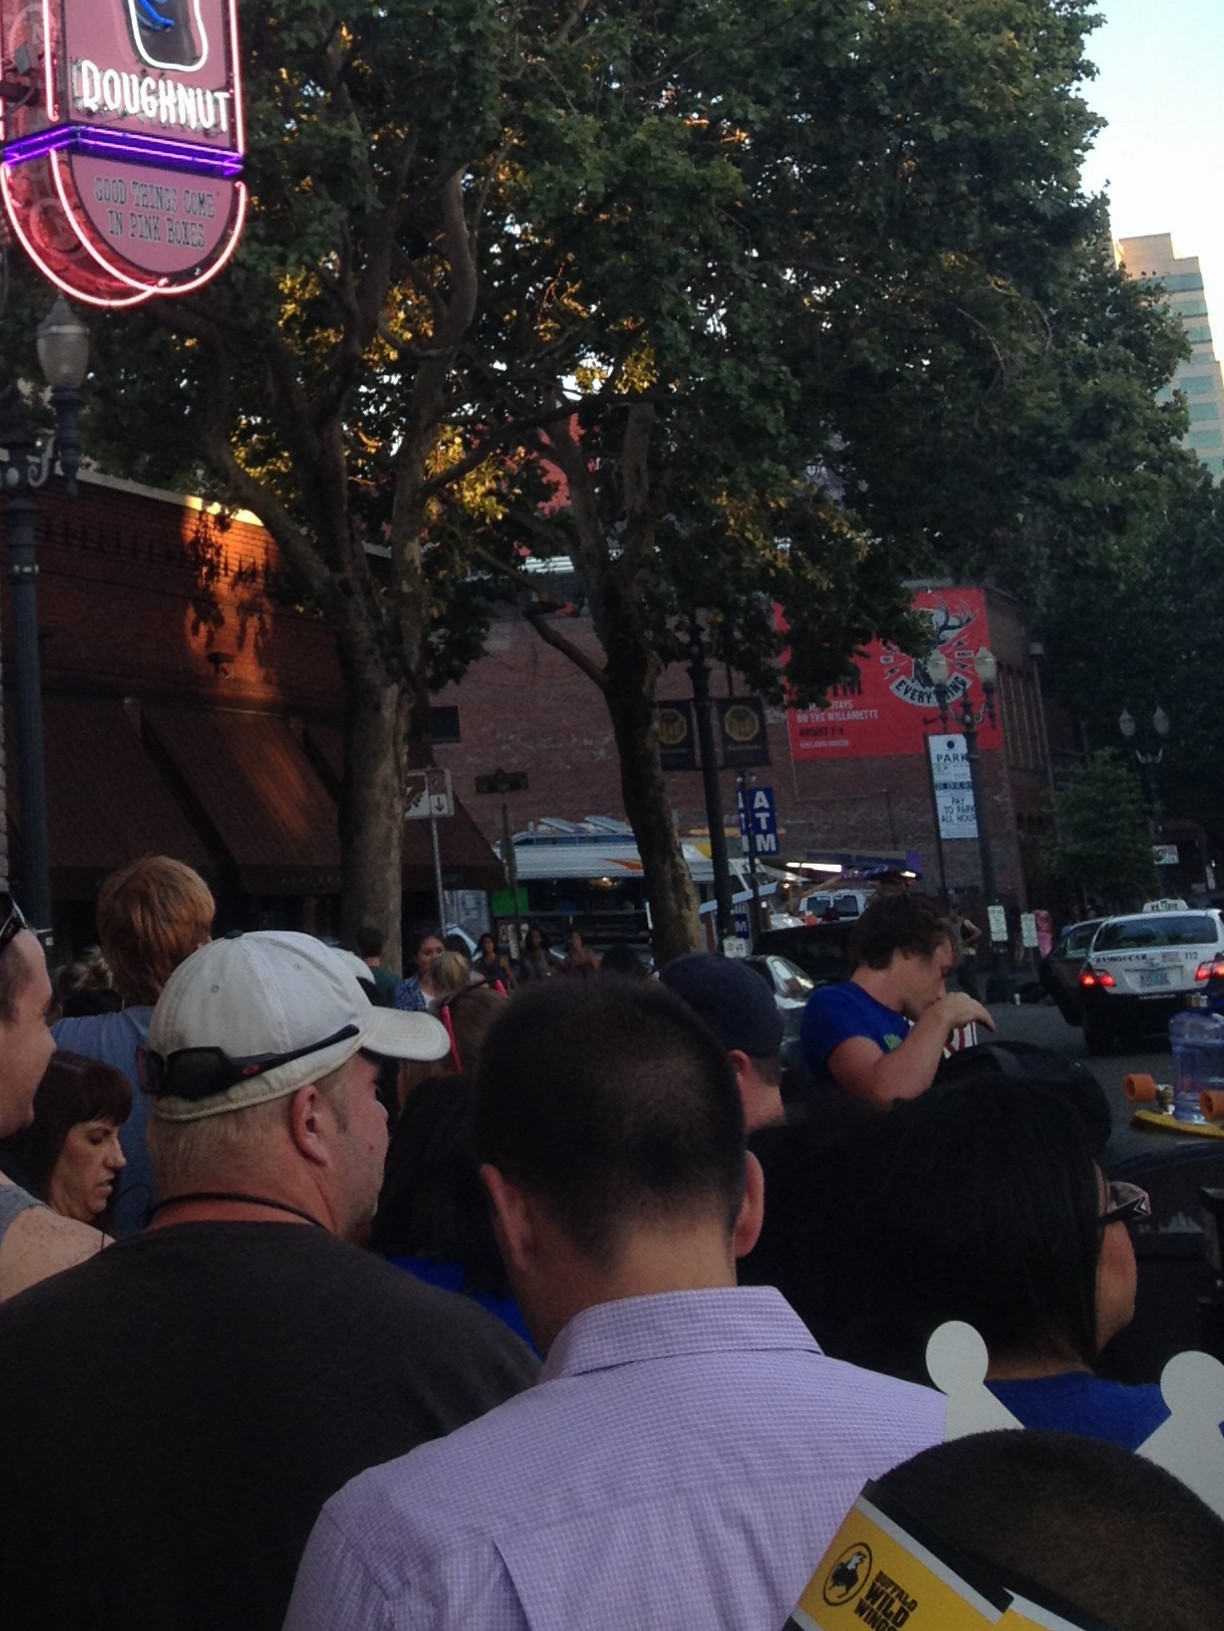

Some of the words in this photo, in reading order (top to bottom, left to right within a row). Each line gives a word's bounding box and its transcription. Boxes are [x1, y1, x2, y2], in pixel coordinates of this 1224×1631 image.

[80, 60, 230, 133] DOUGHNUT
[94, 175, 127, 206] GOOD
[131, 179, 178, 214] THINGS
[183, 188, 216, 219] COME
[108, 209, 124, 236] IN
[129, 212, 162, 242] PINK
[166, 216, 206, 248] BOXES
[894, 675, 967, 704] EVERYING
[752, 790, 777, 852] ATM
[1184, 951, 1199, 960] 112
[865, 1580, 910, 1628] WILD
[874, 1570, 918, 1613] BUFFALO
